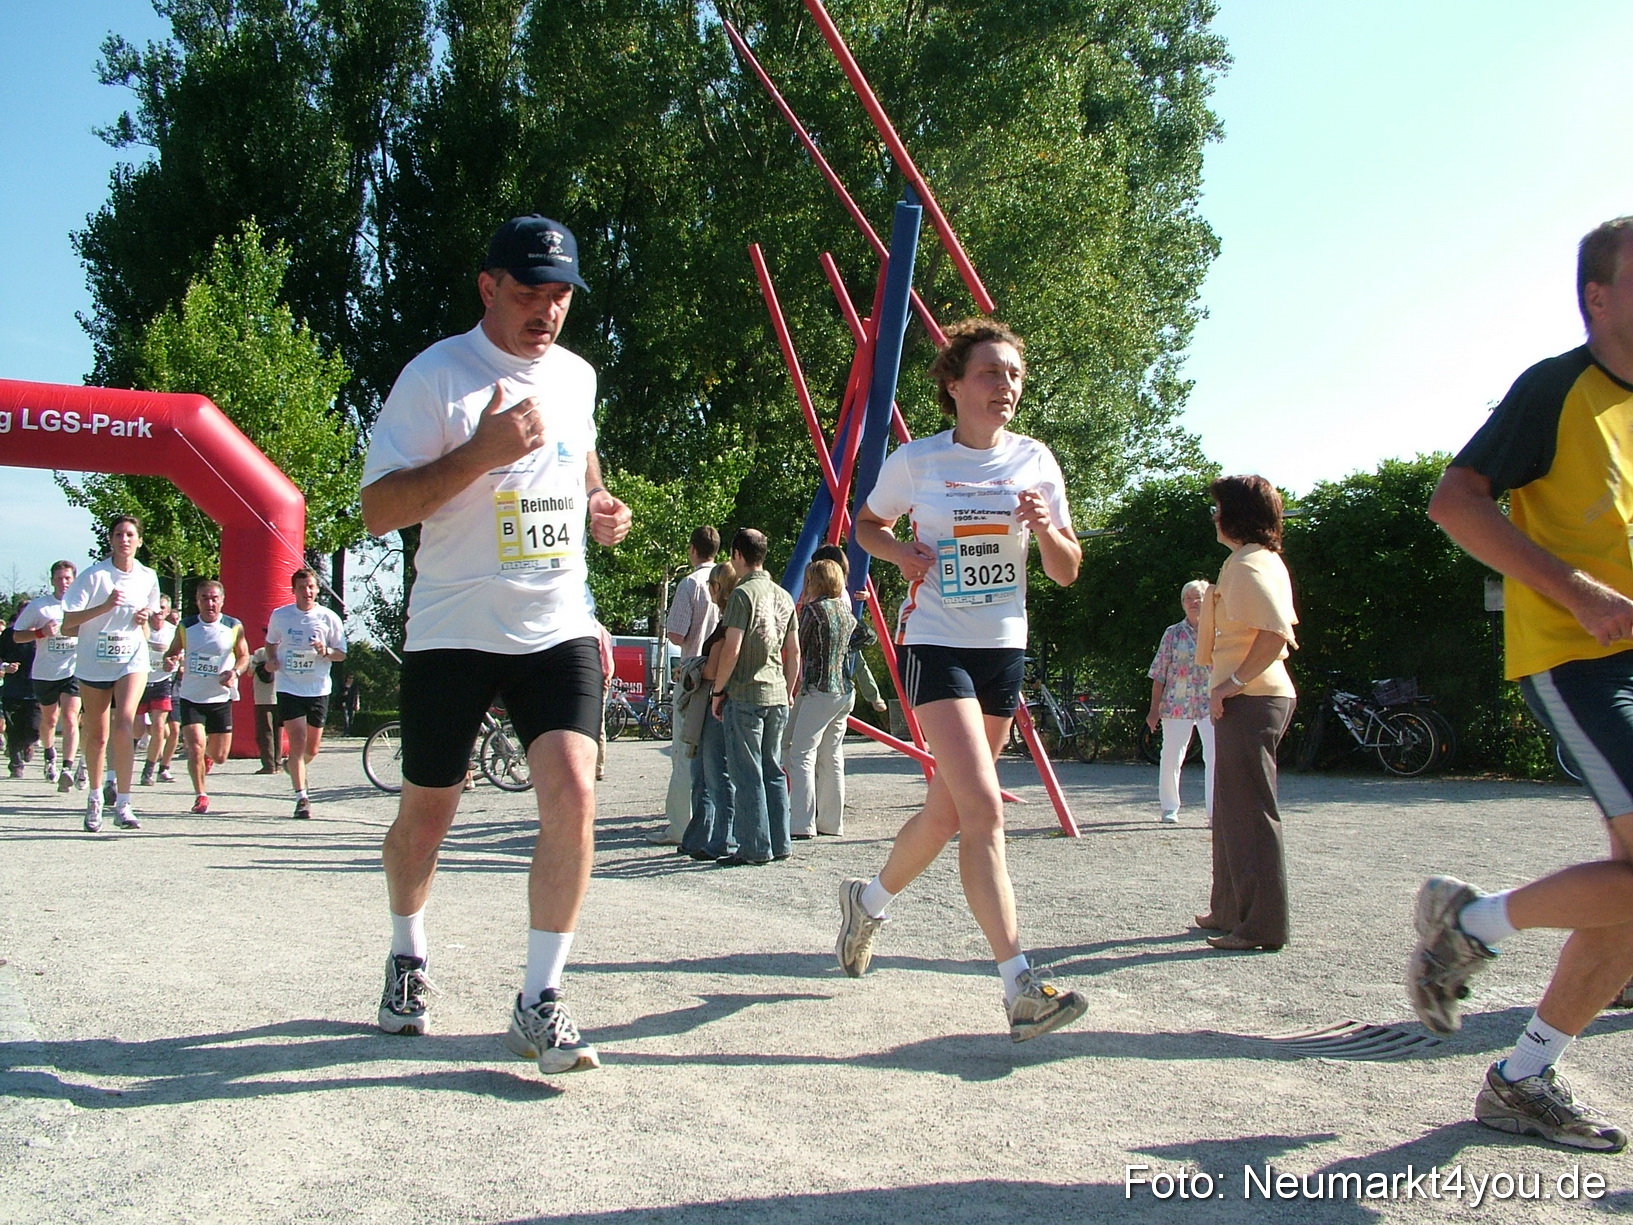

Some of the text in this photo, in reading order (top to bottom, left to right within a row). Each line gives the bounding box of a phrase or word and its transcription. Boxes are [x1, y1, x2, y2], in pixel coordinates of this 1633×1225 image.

[21, 407, 153, 438] LGS-Park
[521, 497, 574, 513] Reinhold
[503, 522, 514, 535] B
[526, 523, 570, 549] 184
[960, 543, 1000, 557] Regina
[944, 564, 954, 575] B
[963, 563, 1016, 587] 3023
[107, 645, 133, 655] 2922
[197, 663, 219, 673] 2638
[292, 660, 314, 669] 3147
